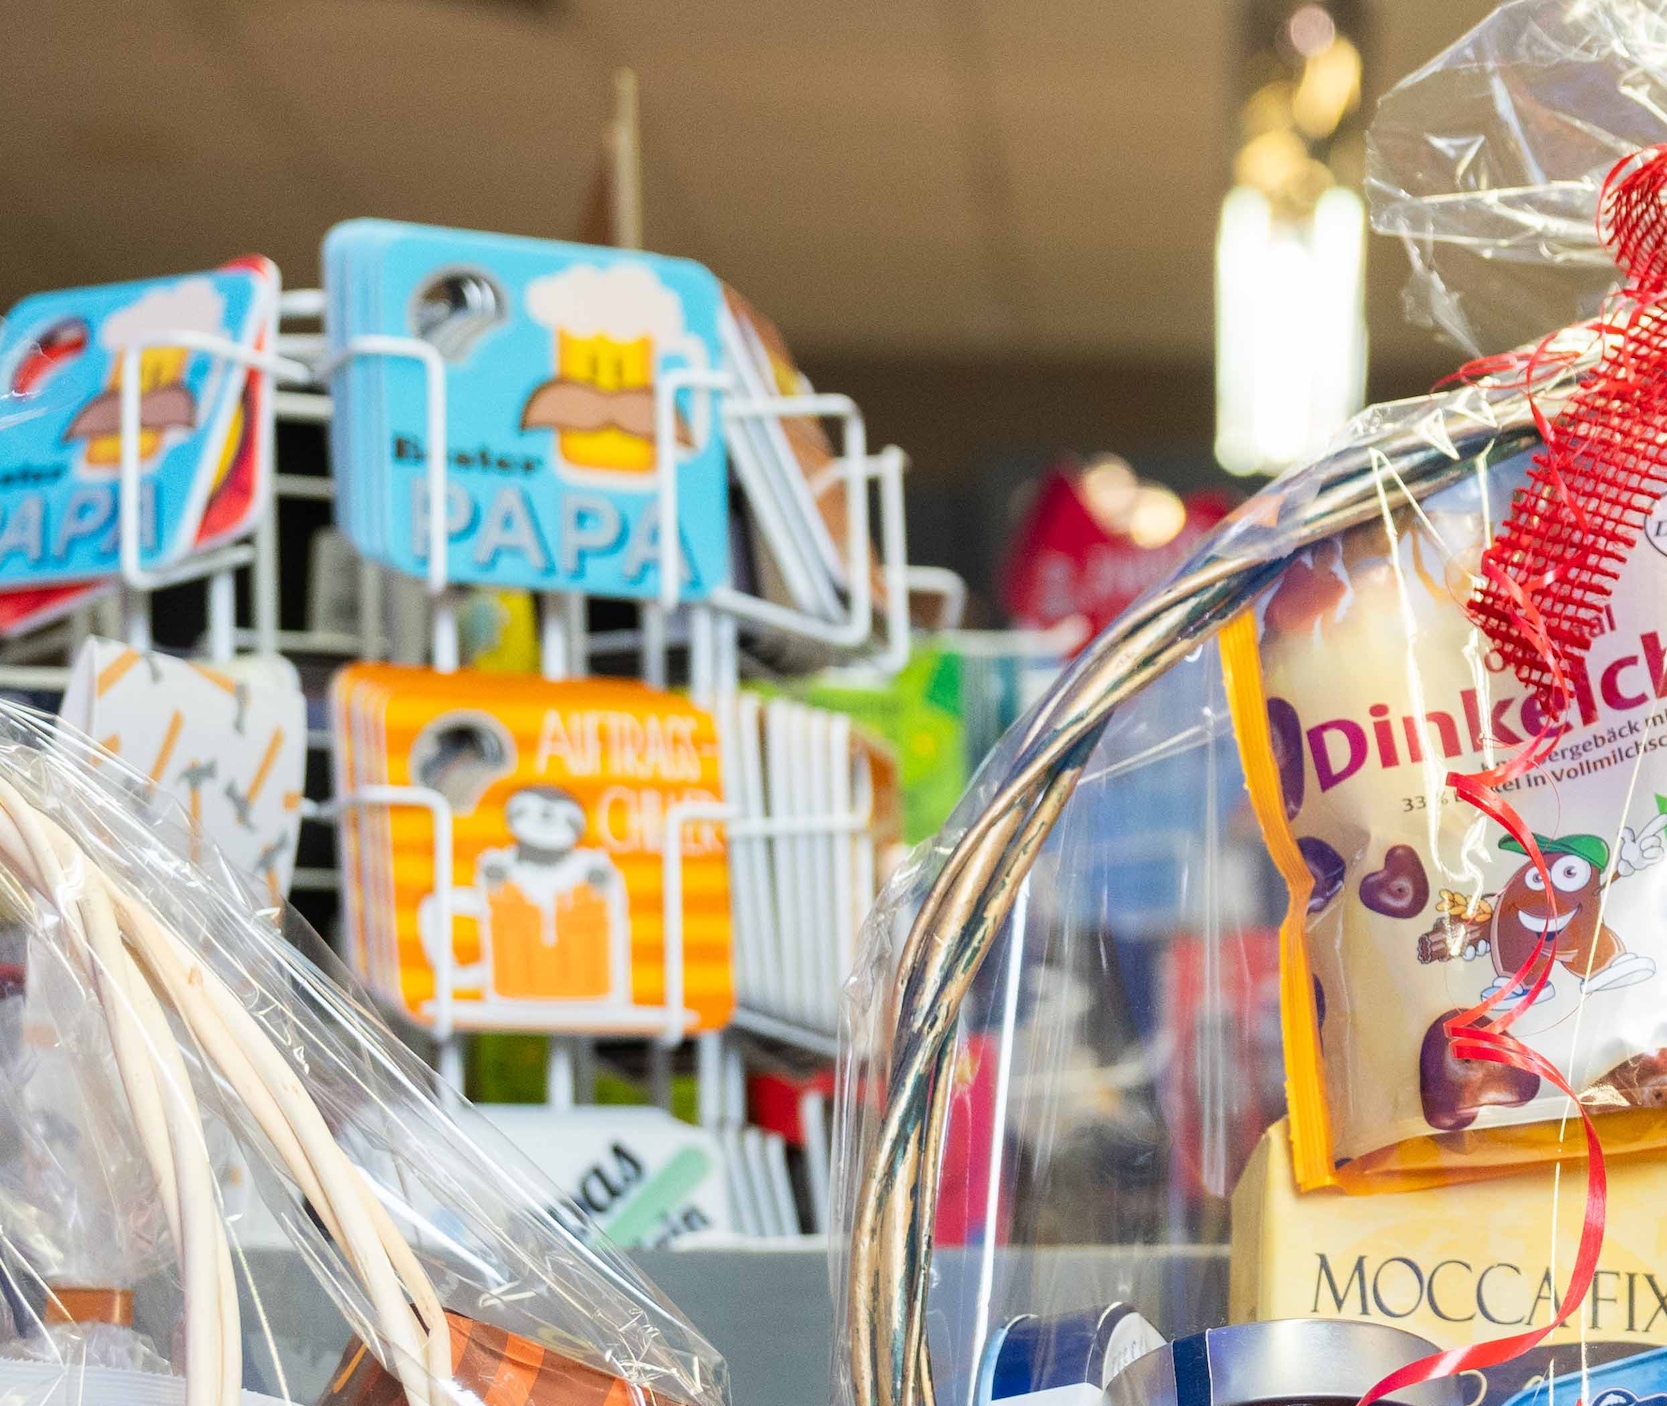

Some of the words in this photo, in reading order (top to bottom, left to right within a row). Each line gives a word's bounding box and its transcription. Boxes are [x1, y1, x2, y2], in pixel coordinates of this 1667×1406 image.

[0, 482, 160, 560] APA
[408, 482, 698, 583] PAPA
[1311, 1252, 1561, 1328] MOCCA
